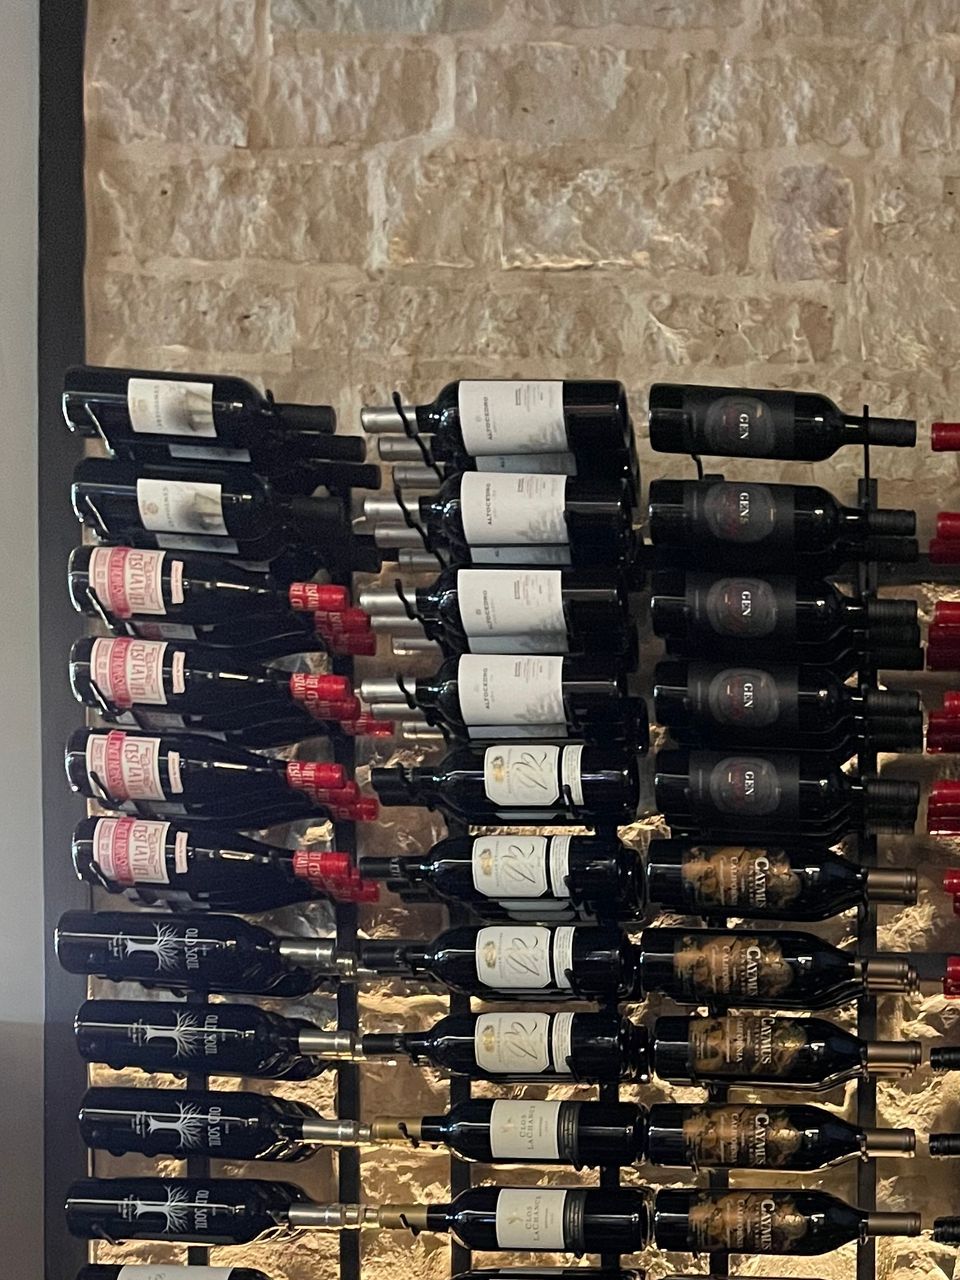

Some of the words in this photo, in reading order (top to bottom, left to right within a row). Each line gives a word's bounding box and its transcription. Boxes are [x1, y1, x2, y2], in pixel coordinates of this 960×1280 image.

[482, 396, 493, 440] ALTOCEDRO
[485, 483, 493, 525] ALTOCEDRO
[131, 574, 145, 584] LA
[482, 590, 493, 630] ALTOCEDRO
[132, 664, 145, 674] LA
[482, 668, 490, 710] ALTOCEDRO
[125, 743, 141, 764] C'EST
[129, 767, 142, 778] LA
[133, 825, 147, 843] C'EST
[135, 846, 147, 855] LA
[185, 928, 198, 947] OLD
[184, 947, 199, 970] SOUL
[204, 1033, 218, 1054] SOUL
[760, 1017, 775, 1064] CAYMUS
[207, 1107, 221, 1124] OLD
[519, 1114, 527, 1138] CLOS
[207, 1126, 221, 1147] SOUL
[754, 1113, 770, 1165] CAYMUS
[194, 1208, 208, 1230] SOUL
[525, 1206, 533, 1230] CLOS
[759, 1199, 775, 1250] CAYMUS
